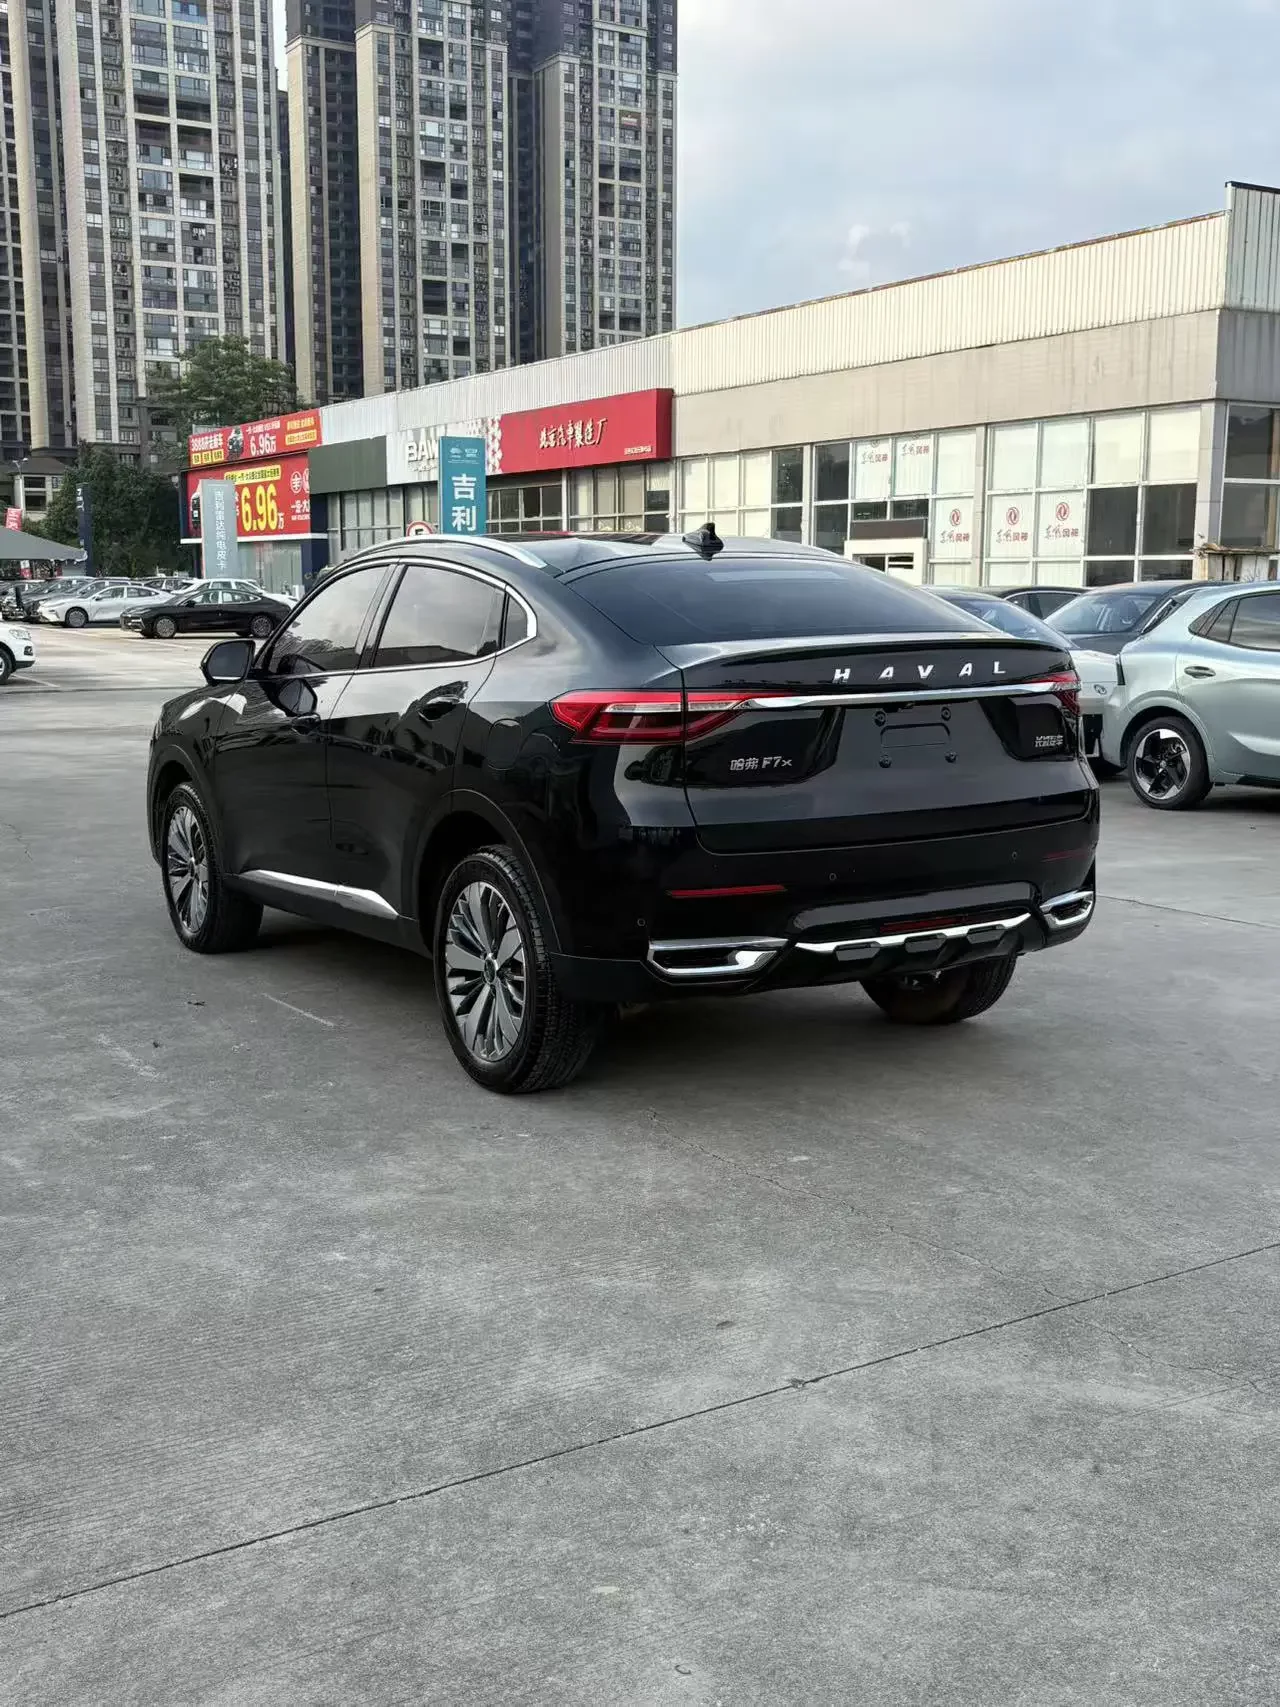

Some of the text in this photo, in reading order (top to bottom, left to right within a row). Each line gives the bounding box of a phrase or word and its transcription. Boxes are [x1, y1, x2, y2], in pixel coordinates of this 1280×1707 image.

[451, 473, 477, 532] 吉利
[832, 660, 1006, 683] HAVAL
[761, 756, 793, 769] F7x
